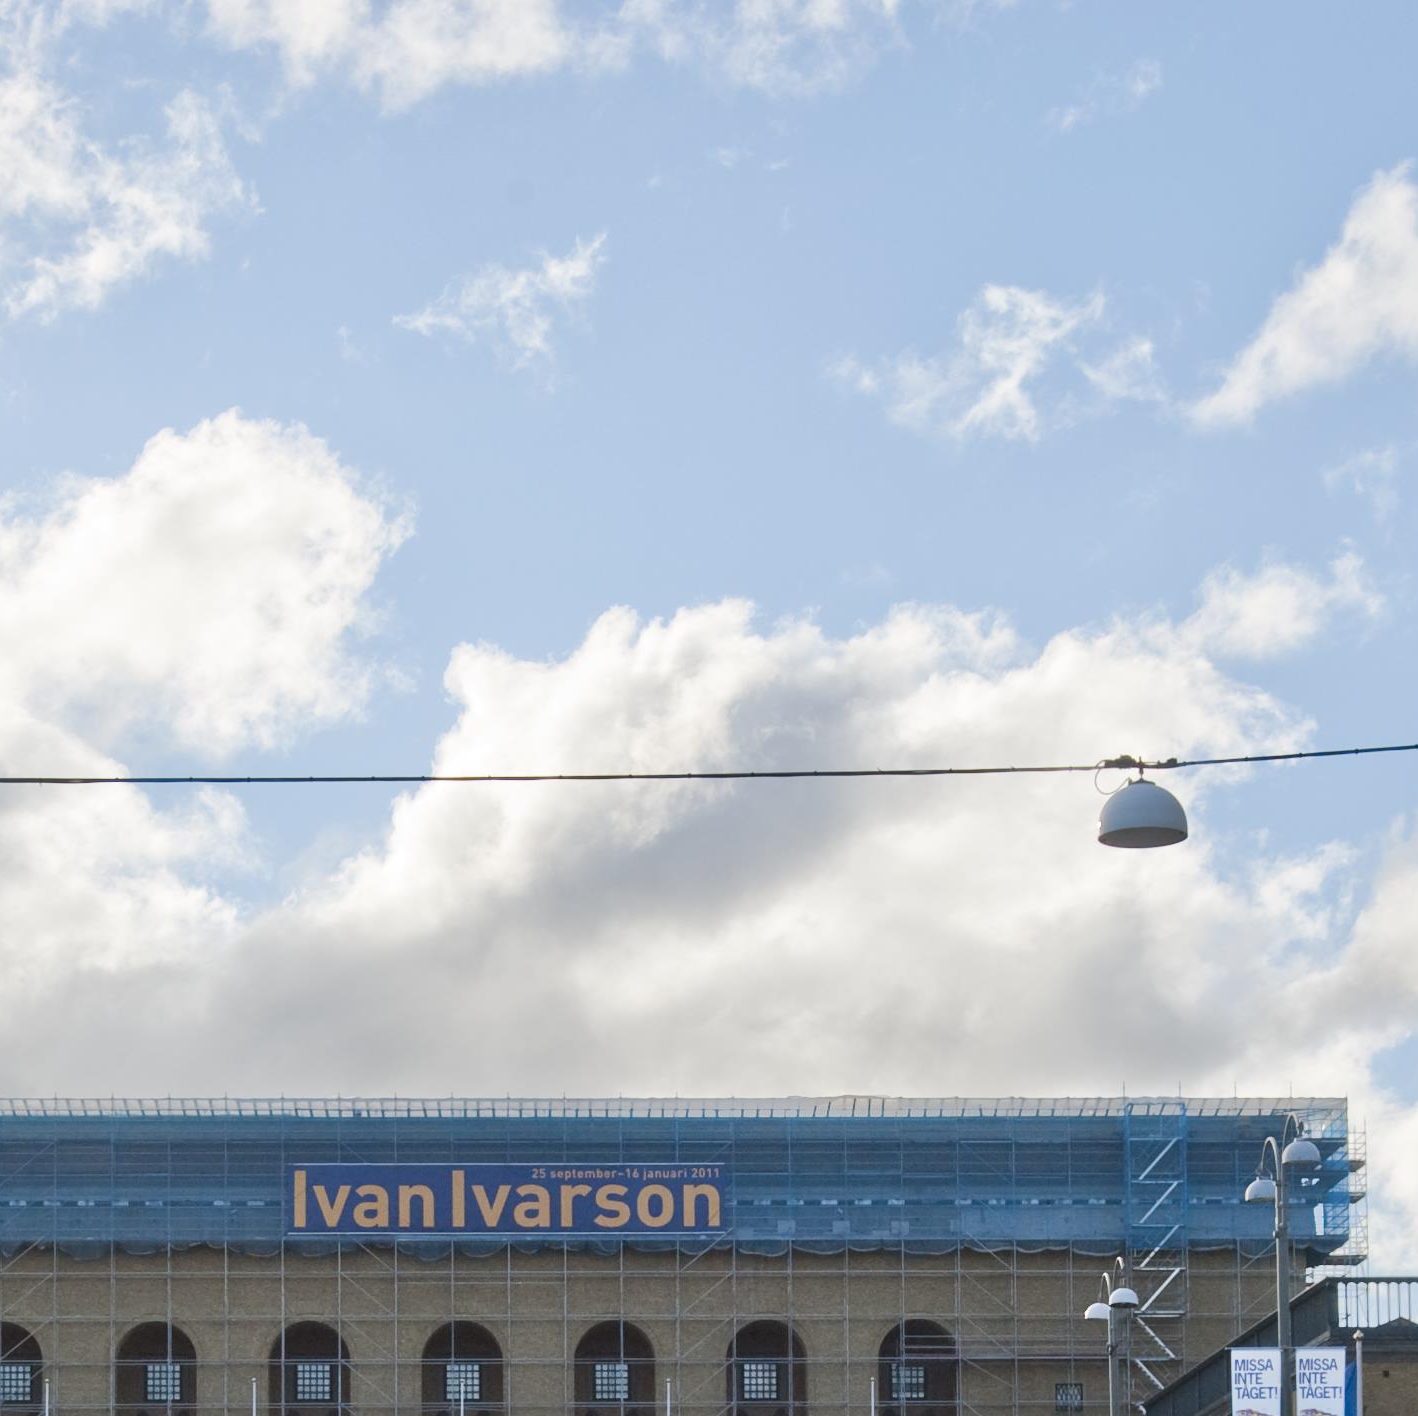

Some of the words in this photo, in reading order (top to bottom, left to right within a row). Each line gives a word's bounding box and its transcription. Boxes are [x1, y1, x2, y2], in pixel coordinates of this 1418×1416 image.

[532, 1168, 546, 1179] 25
[642, 1168, 688, 1181] januari
[691, 1167, 720, 1178] 2011
[293, 1170, 435, 1228] Ivan
[452, 1170, 721, 1228] Ivarson
[1234, 1359, 1273, 1371] MISSA
[1299, 1358, 1338, 1371] MISSA
[1234, 1372, 1263, 1384] INTE
[1299, 1371, 1328, 1384] INTE
[1235, 1385, 1278, 1399] TÅGET!
[1300, 1385, 1342, 1399] TÅGET!
